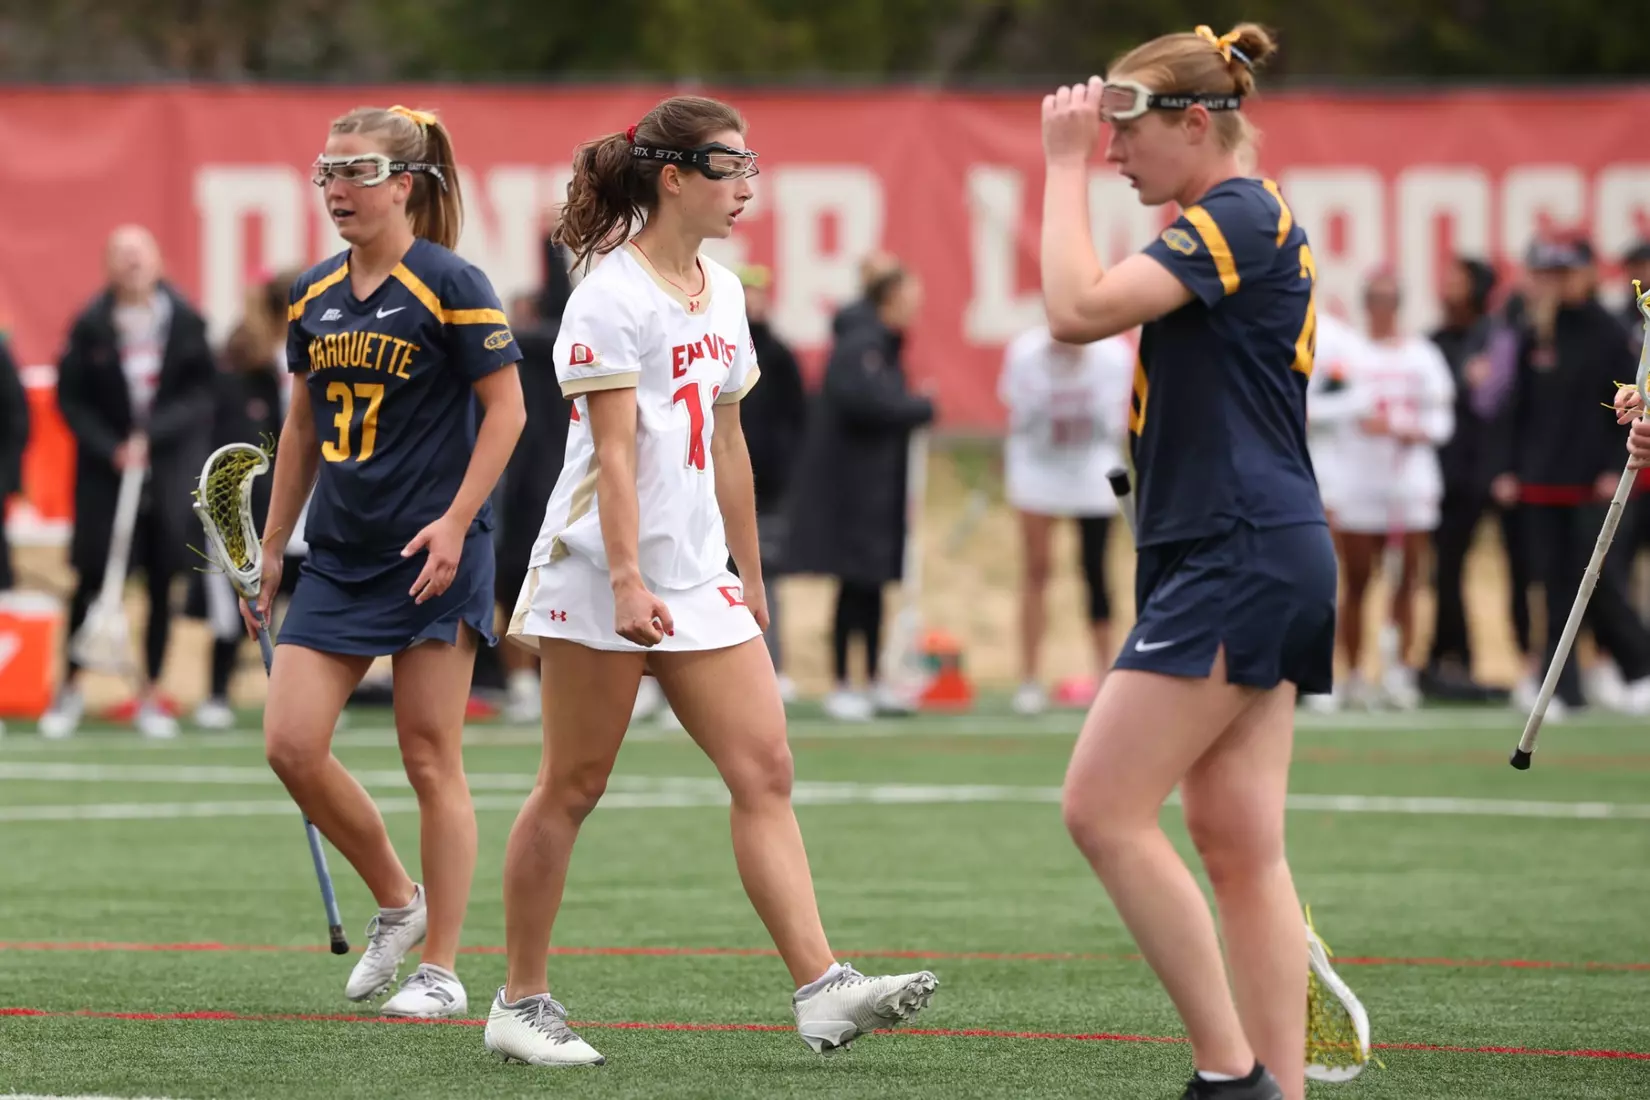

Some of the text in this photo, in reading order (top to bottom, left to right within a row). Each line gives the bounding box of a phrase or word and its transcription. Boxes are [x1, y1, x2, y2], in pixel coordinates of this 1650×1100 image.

[633, 146, 683, 161] STX STX
[321, 381, 385, 463] 37
